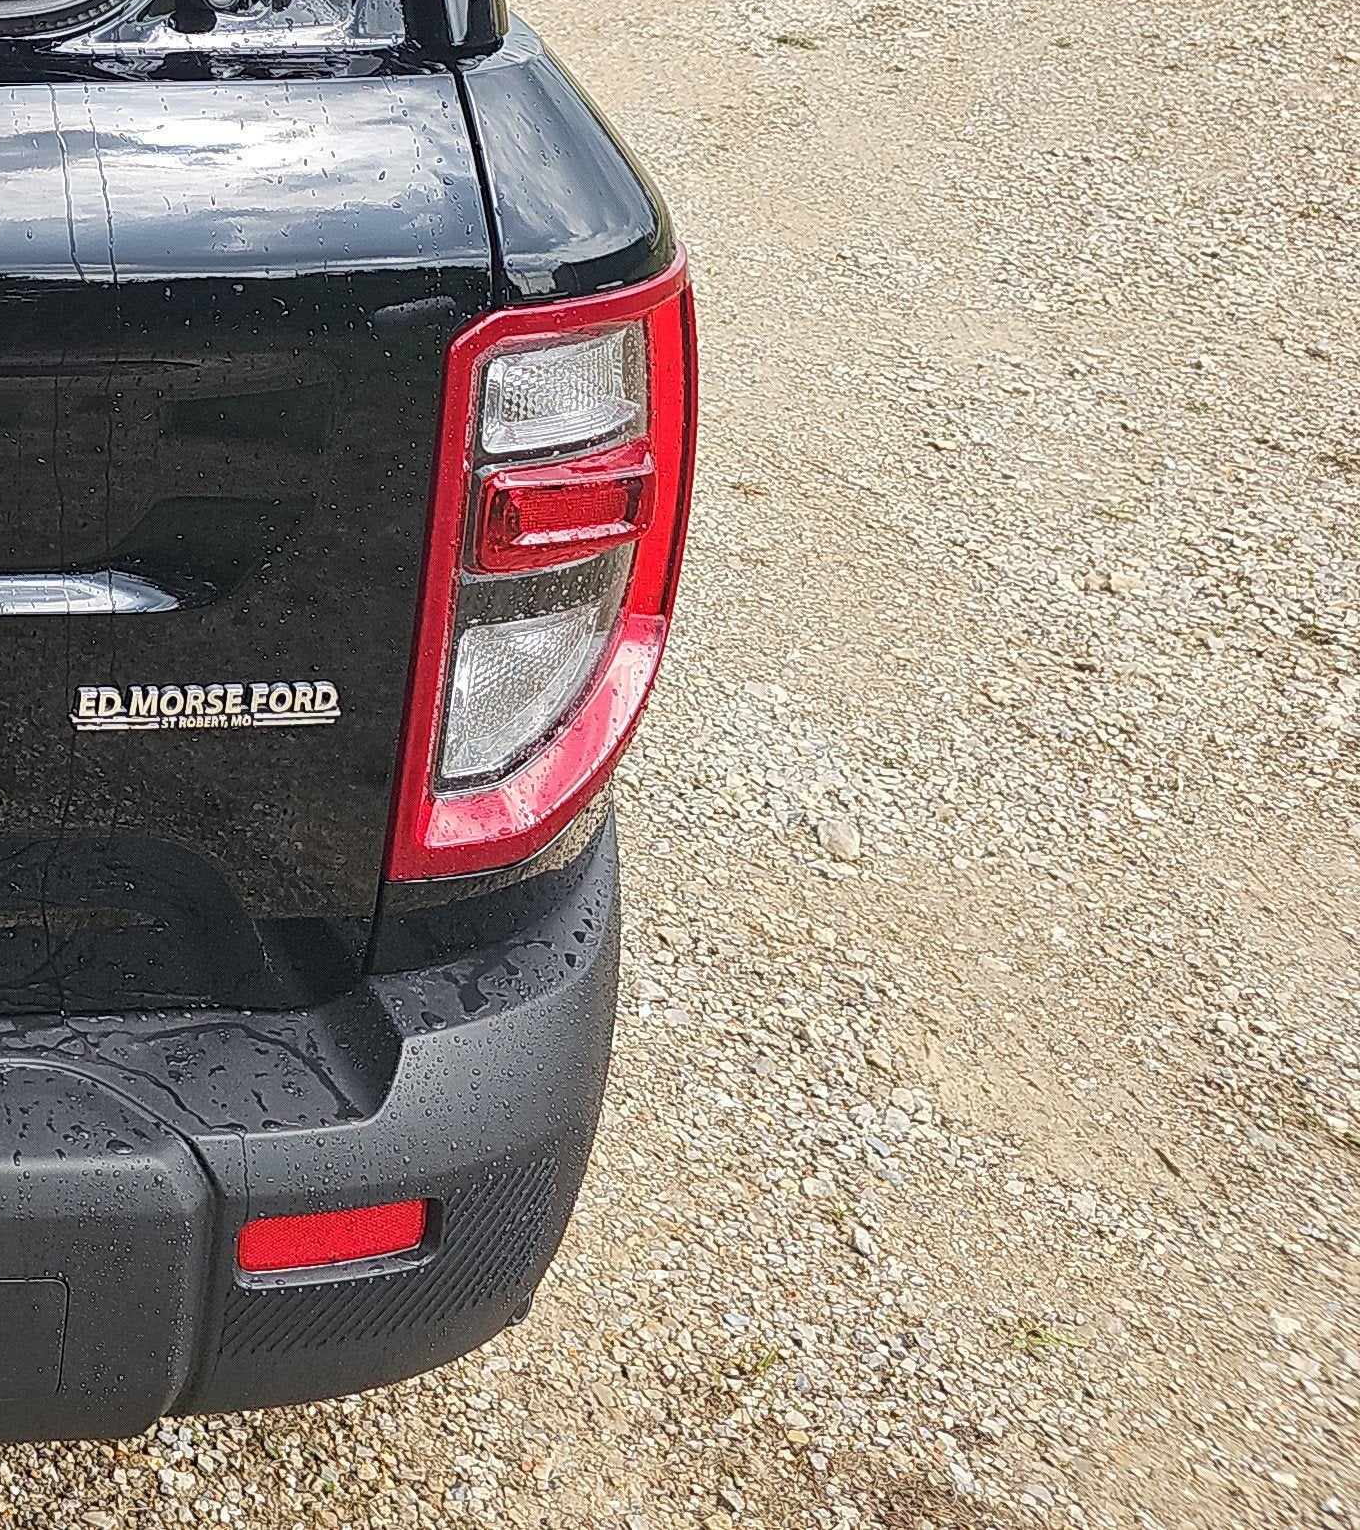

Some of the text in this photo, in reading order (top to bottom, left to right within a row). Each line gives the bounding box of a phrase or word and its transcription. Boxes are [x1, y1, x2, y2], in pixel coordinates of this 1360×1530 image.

[77, 680, 338, 717] ED MORSE FORD
[161, 716, 177, 728] ST
[230, 714, 252, 727] MO
